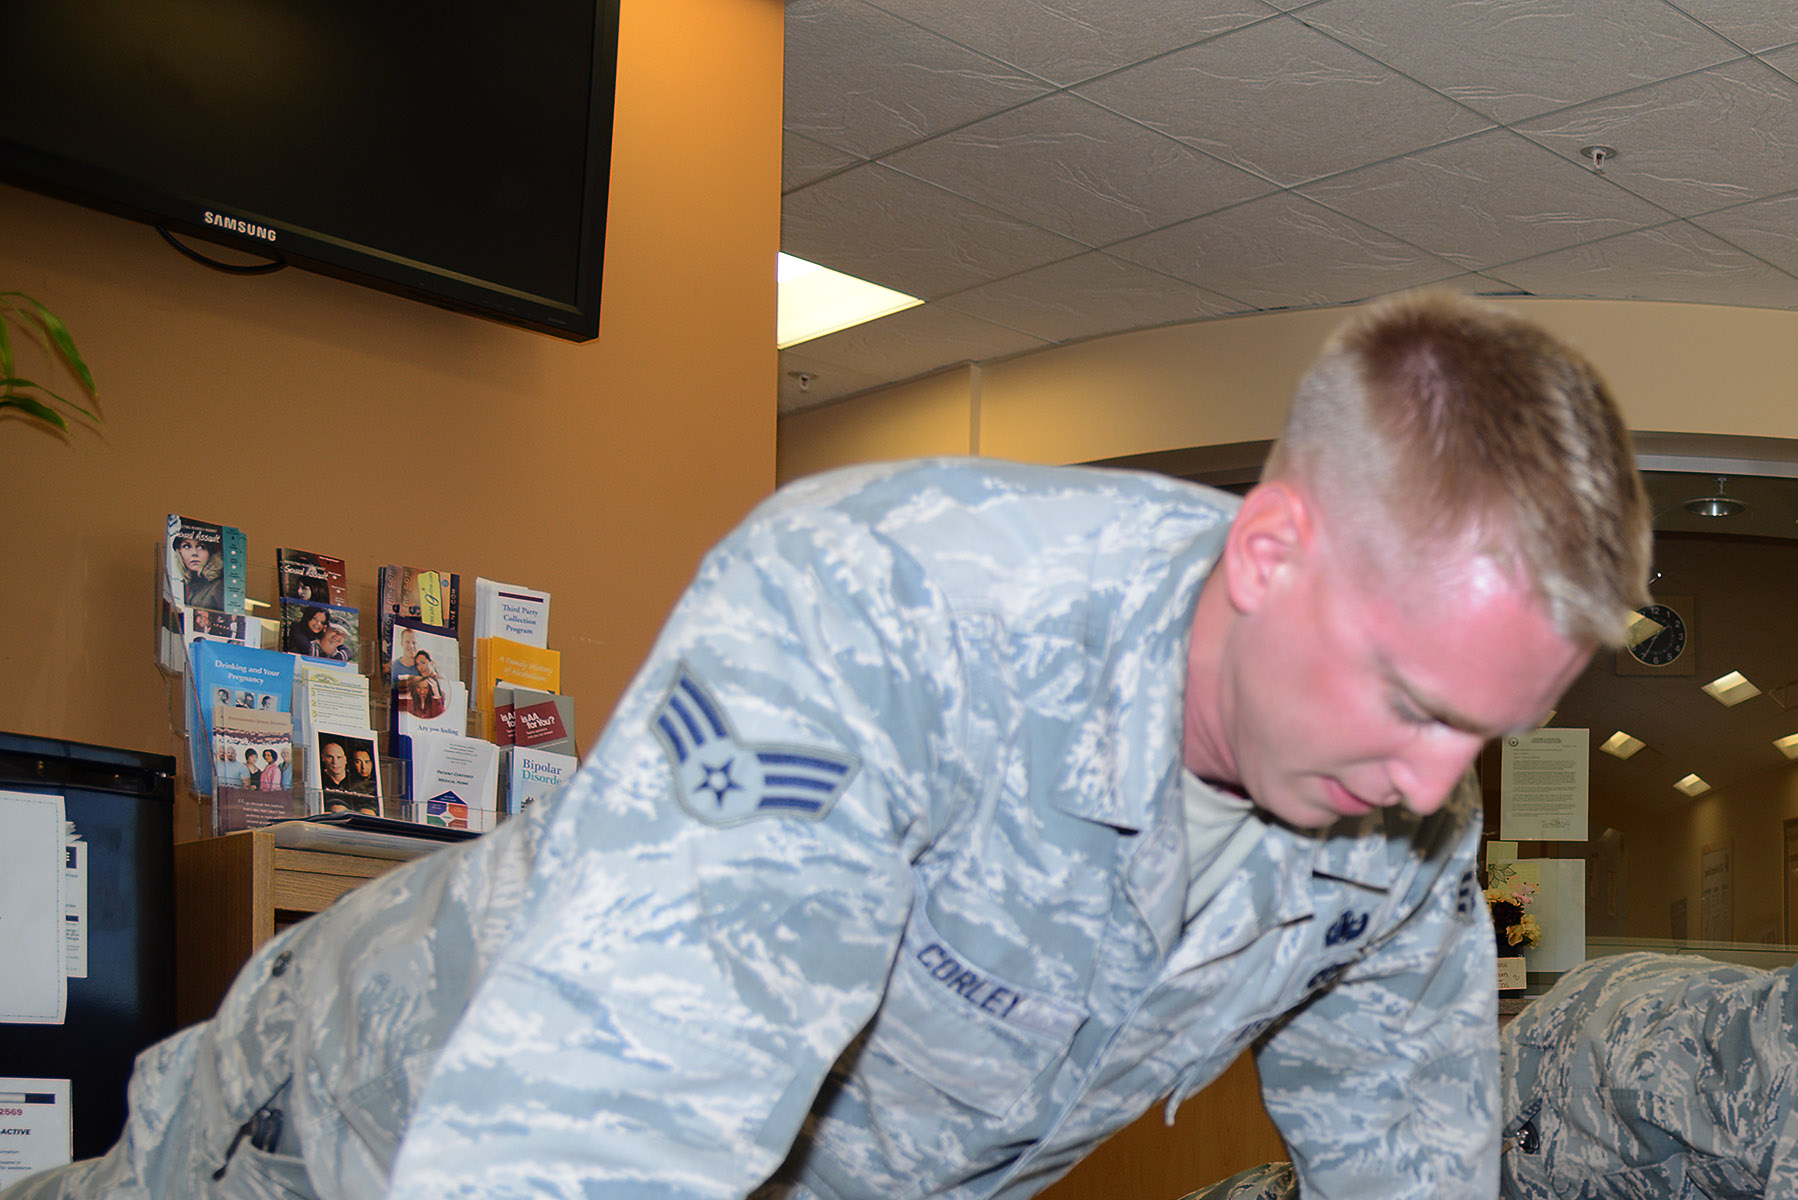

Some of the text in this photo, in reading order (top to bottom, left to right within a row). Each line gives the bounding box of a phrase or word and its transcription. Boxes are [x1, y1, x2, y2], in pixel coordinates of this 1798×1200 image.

[204, 210, 277, 242] SAMSUNG
[502, 604, 539, 618] Third Party
[1650, 607, 1660, 615] 12
[1666, 610, 1671, 618] 1
[503, 614, 537, 625] Collection
[1674, 620, 1680, 628] 2
[505, 624, 533, 635] Program
[1678, 632, 1684, 640] 3
[1653, 656, 1659, 664] 6
[1666, 652, 1672, 661] 5
[215, 659, 280, 677] Drinking and Your
[228, 672, 265, 685] Pregnancy
[526, 716, 556, 730] for You?
[527, 712, 541, 723] AA
[440, 727, 459, 737] feeling
[522, 758, 563, 775] Bipolar
[521, 769, 563, 785] Disorde
